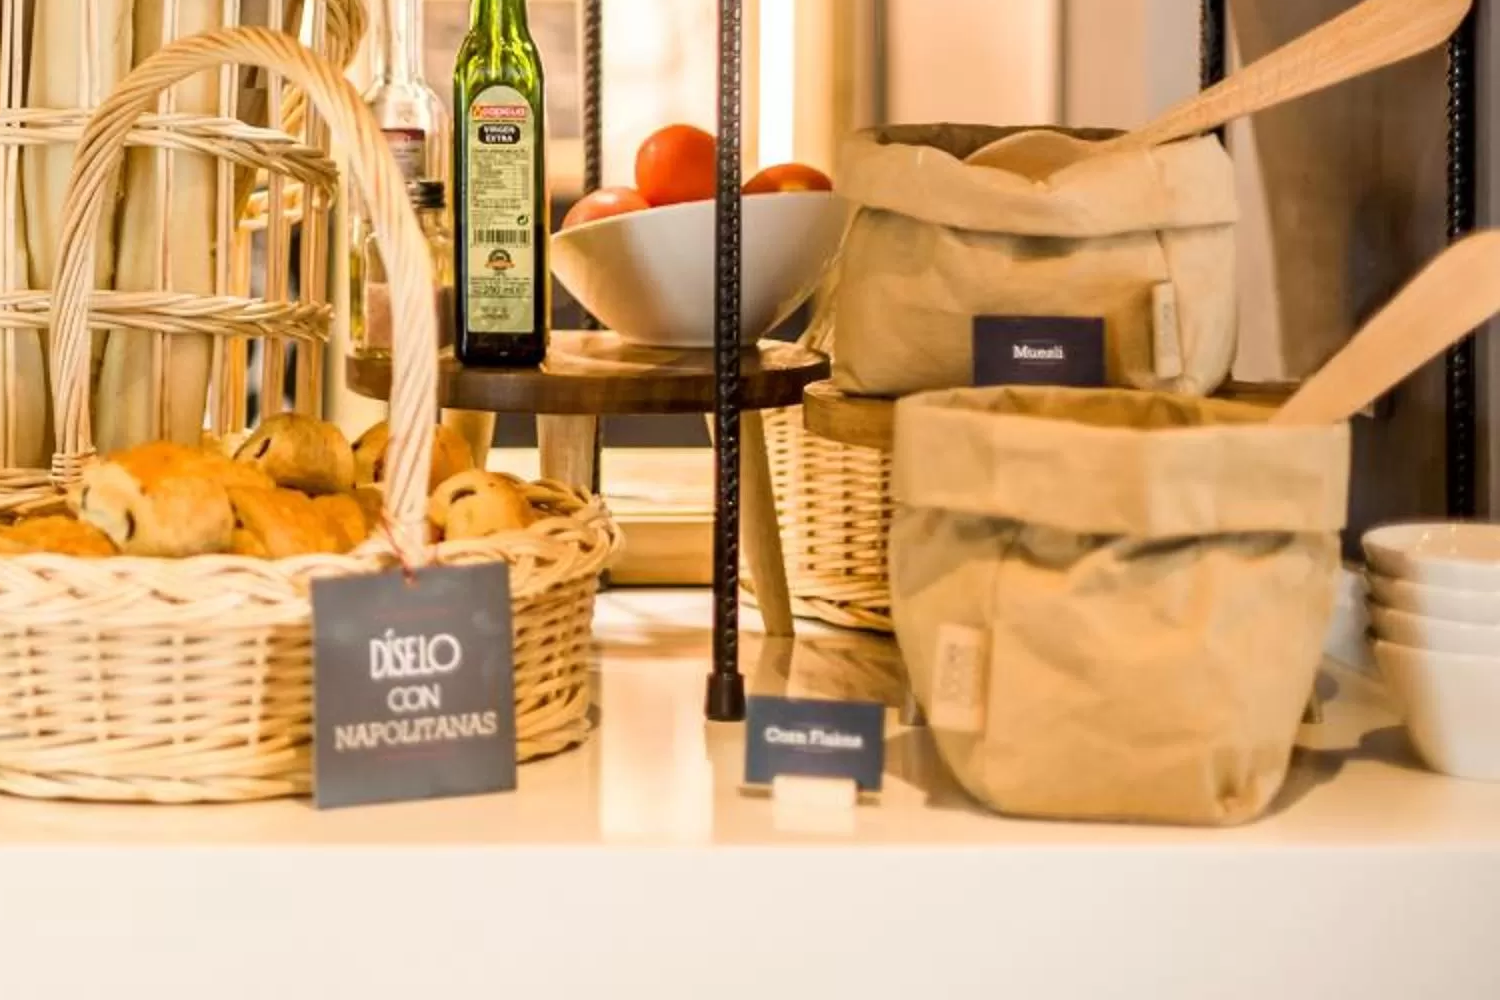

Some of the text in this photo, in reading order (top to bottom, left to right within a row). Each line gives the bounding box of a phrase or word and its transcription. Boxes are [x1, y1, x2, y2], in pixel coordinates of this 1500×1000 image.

[369, 628, 463, 680] DÍSELO
[387, 683, 441, 713] CON
[334, 710, 498, 750] NAPOLITANAS
